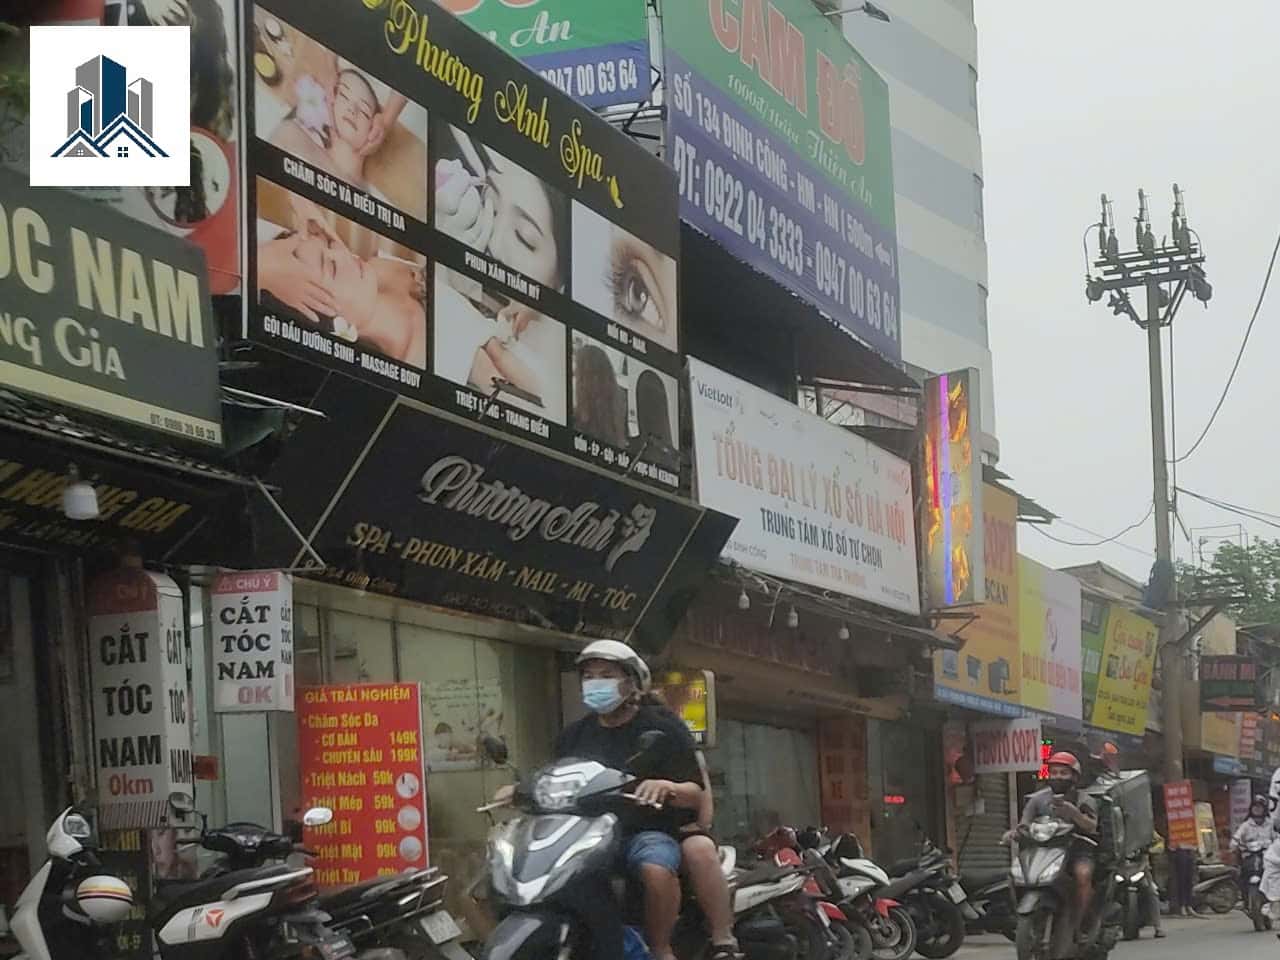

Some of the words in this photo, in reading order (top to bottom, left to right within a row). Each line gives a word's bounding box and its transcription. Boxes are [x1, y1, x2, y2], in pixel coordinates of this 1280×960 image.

[509, 10, 574, 48] An
[576, 65, 595, 96] 00
[598, 60, 616, 93] 63
[619, 58, 639, 90] 64
[494, 80, 550, 148] Anh
[560, 119, 603, 189] Spa
[673, 71, 692, 118] SỐ
[696, 93, 720, 139] 134
[722, 112, 753, 165] ĐỊNH
[756, 138, 788, 192] CÔNG
[283, 157, 314, 186] CHĂM
[317, 173, 337, 197] SÓC
[339, 184, 351, 206] VÀ
[354, 193, 375, 215] ĐIỀU
[377, 203, 391, 227] TRỊ
[393, 214, 405, 232] DA
[704, 159, 744, 236] 0922
[748, 190, 765, 250] 04
[769, 206, 803, 276] 3333
[816, 241, 846, 305] 0947
[850, 266, 864, 319] 00
[866, 280, 881, 330] 63
[883, 291, 897, 340] 64
[71, 226, 205, 348] NAM
[264, 315, 280, 338] GỘI
[282, 321, 300, 344] ĐẦU
[334, 342, 354, 364] SINH
[361, 353, 399, 380] MASSAGE
[401, 367, 420, 388] BODY
[456, 390, 478, 413] TRIỆT
[713, 421, 763, 490] TỔNG
[767, 451, 797, 509] ĐẠI
[801, 464, 817, 510] LÝ
[822, 466, 842, 519] XỔ
[846, 479, 863, 527] SỐ
[760, 508, 795, 540] TRUNG
[798, 518, 819, 549] TÂM
[821, 523, 834, 551] XỔ
[836, 529, 847, 557] SỐ
[849, 536, 861, 566] TỰ
[861, 543, 883, 573] CHỌN
[347, 521, 393, 554] SPA
[400, 537, 458, 571] PHUN
[513, 566, 559, 595] NAIL
[566, 580, 593, 604] MI
[603, 584, 637, 611] TÓC
[219, 596, 272, 625] CẮT
[100, 623, 149, 666] CẮT
[220, 628, 272, 654] TÓC
[217, 660, 275, 681] NAM
[102, 679, 153, 717] TÓC
[168, 682, 186, 724] TÓC
[360, 686, 411, 704] NGHIỆM
[341, 712, 362, 728] Sóc
[100, 734, 162, 768] NAM
[976, 729, 1010, 765] PHOTO
[1012, 727, 1039, 764] COPY
[170, 749, 191, 783] NAM
